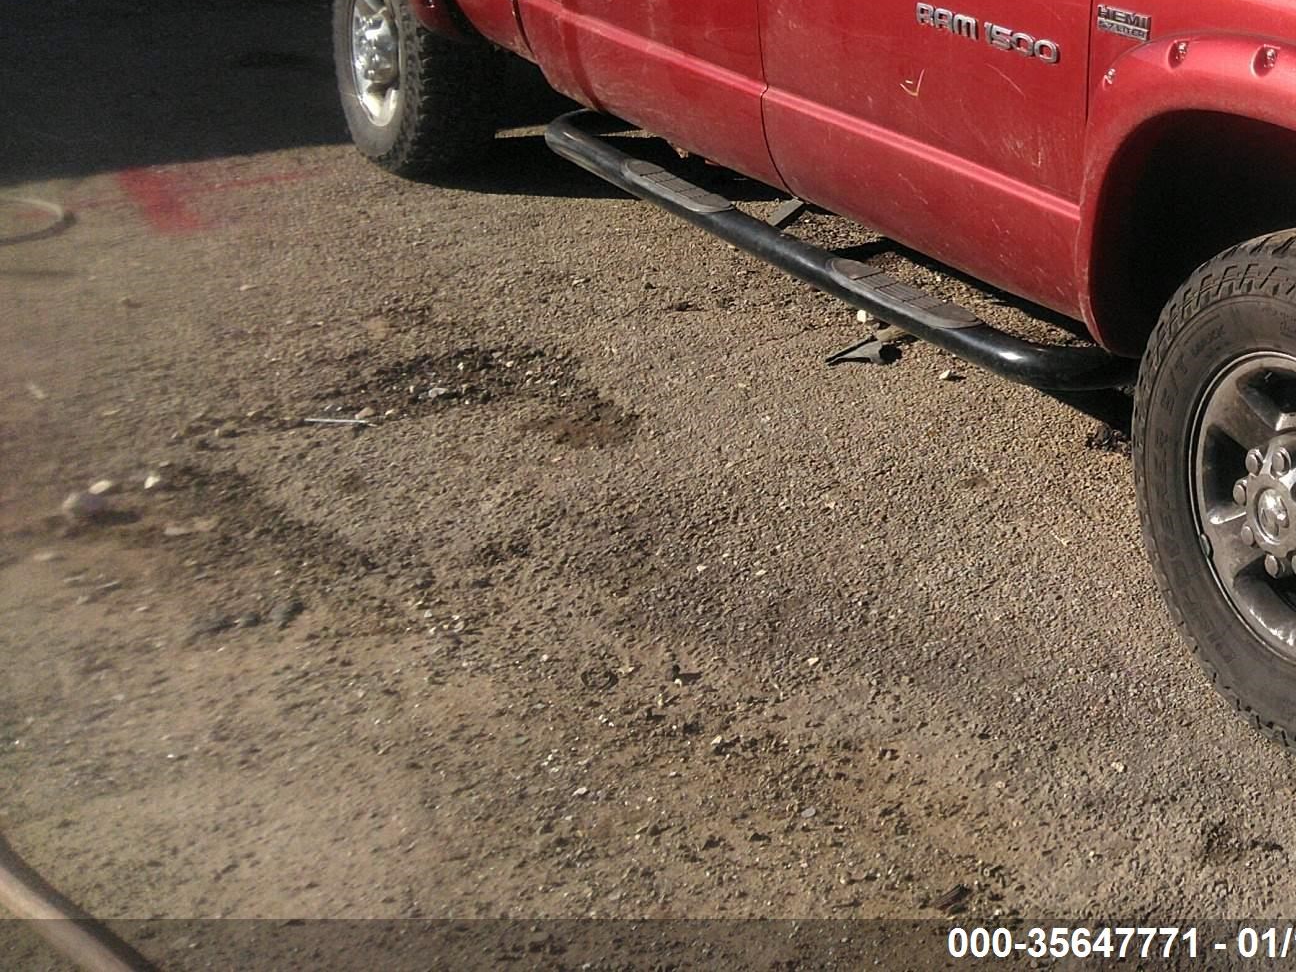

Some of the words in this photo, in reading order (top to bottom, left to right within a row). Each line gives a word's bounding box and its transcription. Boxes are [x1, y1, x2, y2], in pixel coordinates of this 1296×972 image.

[916, 2, 978, 39] RAM
[984, 22, 1060, 63] 1500
[1098, 4, 1148, 29] HEMI
